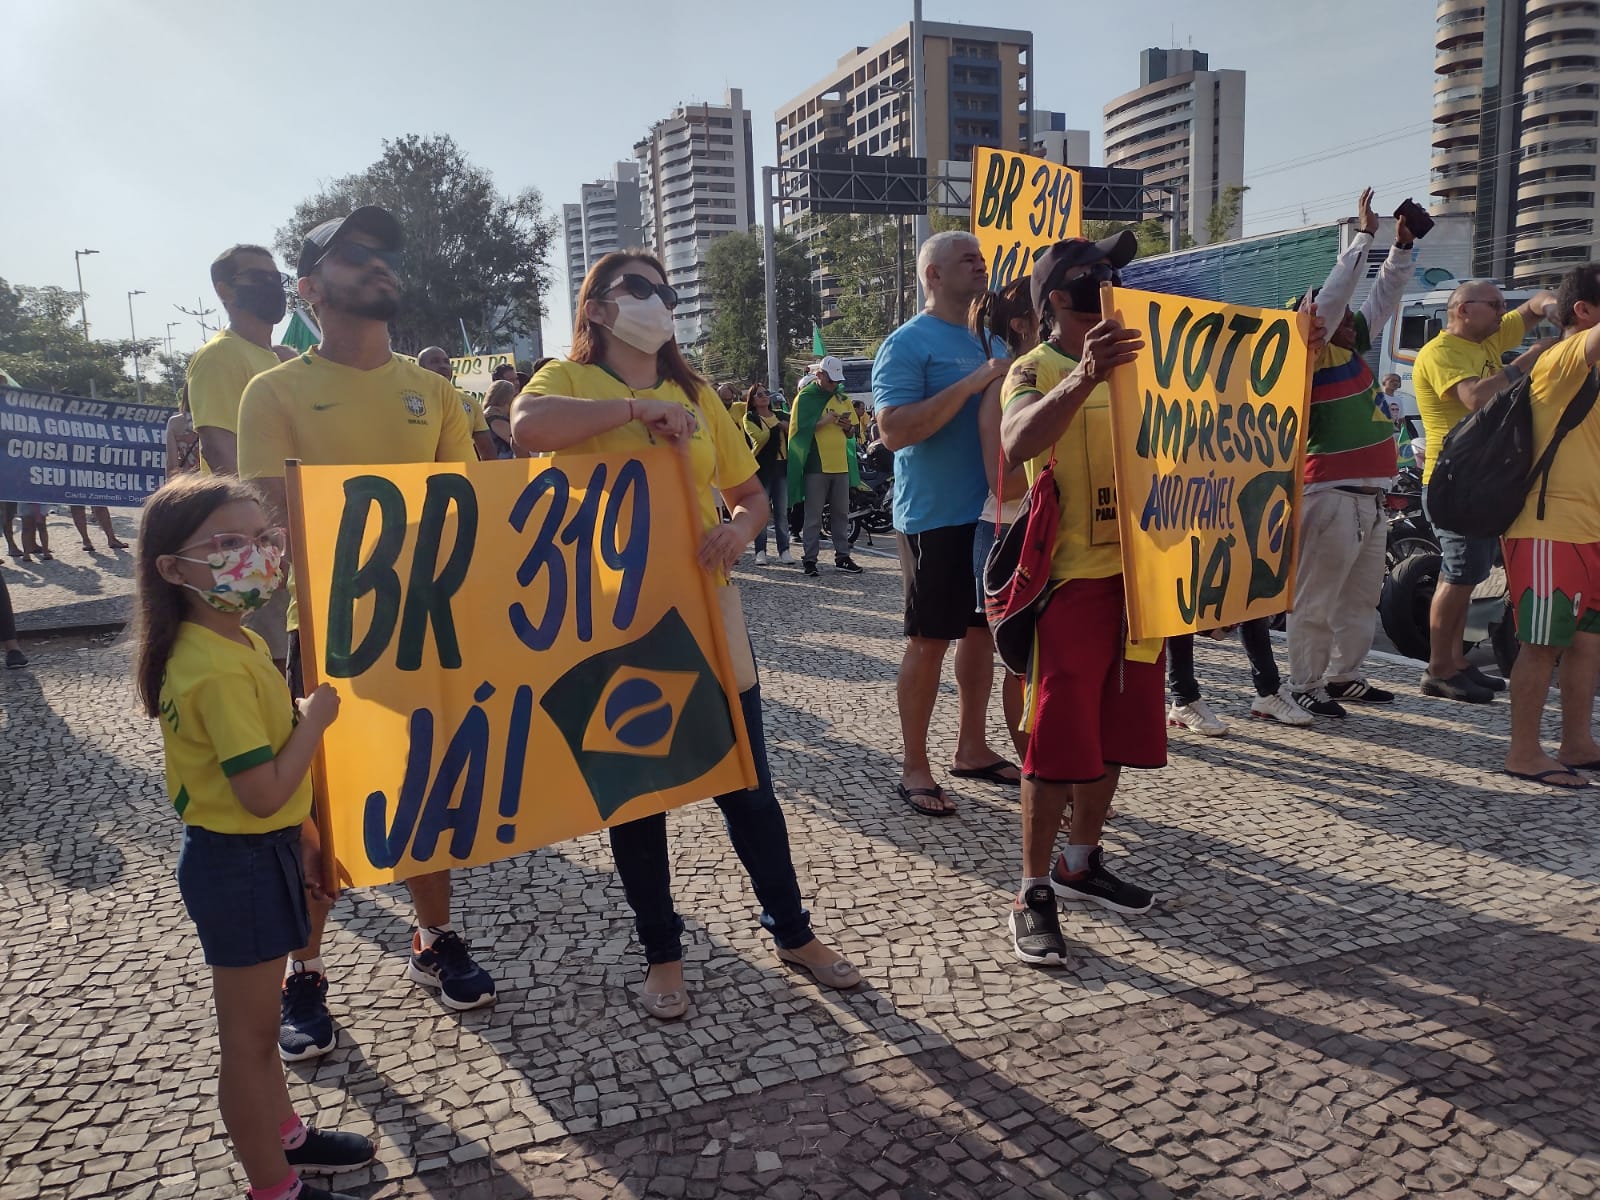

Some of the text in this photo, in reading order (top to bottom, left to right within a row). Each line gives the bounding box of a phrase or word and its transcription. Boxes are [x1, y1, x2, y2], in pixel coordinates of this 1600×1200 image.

[977, 152, 1073, 240] BR 319
[1148, 300, 1290, 397] VOTO
[5, 390, 169, 424] OMAR AZIZ, PEGUE
[44, 417, 110, 441] GORDA
[112, 425, 123, 441] E
[124, 425, 150, 443] VÁ
[1135, 389, 1299, 469] IMPRESSO
[7, 438, 69, 462] COISA
[73, 444, 96, 464] DE
[99, 443, 137, 467] ÚTIL
[29, 466, 66, 487] SEU
[70, 469, 142, 492] IMBECIL
[145, 474, 156, 492] E
[1095, 507, 1117, 522] PARA
[1098, 487, 1111, 506] EU
[1139, 469, 1236, 533] AUDITÁVEL
[325, 457, 651, 679] BR 319
[1176, 532, 1237, 626] JÁ
[362, 680, 533, 870] JÁ!
